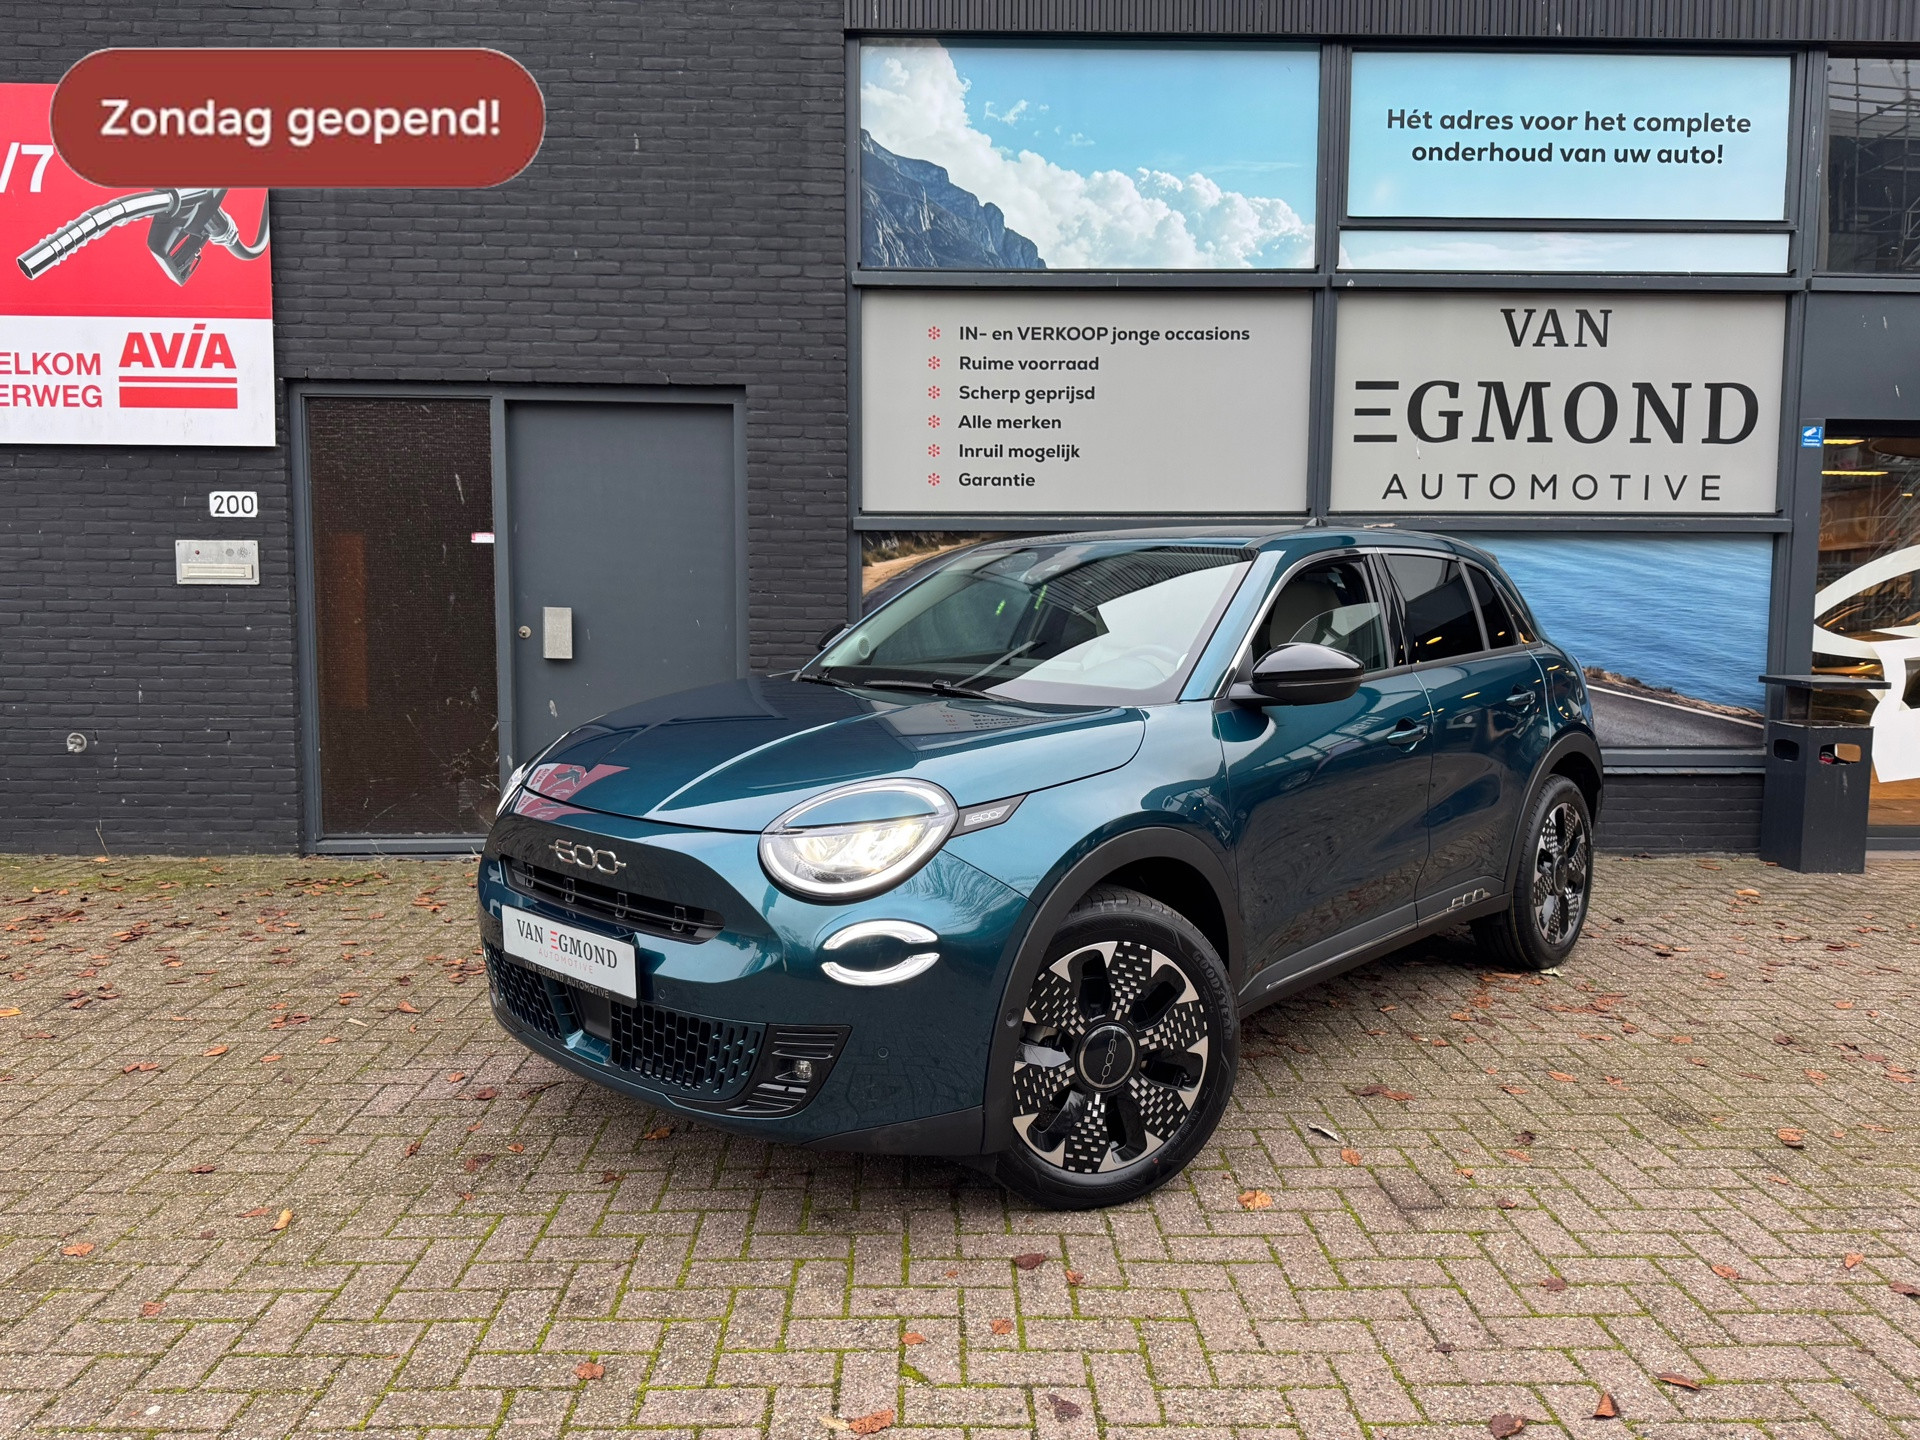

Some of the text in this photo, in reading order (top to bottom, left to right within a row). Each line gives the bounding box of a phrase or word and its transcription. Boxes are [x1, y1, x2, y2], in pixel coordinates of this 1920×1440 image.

[1387, 108, 1752, 135] Hét adres voor het complete
[1411, 141, 1724, 165] onderhoud van uw auto!
[959, 326, 1250, 346] IN- en VERKOOP jonge occasions
[1500, 308, 1613, 348] VAN
[119, 323, 237, 369] AVIA
[959, 355, 1099, 371] Ruime voorraad
[959, 385, 1095, 404] Scherp geprijsd
[957, 414, 1062, 429] Alle merken
[1353, 380, 1759, 445] EGMOND
[959, 443, 1081, 463] Inruil mogelijk
[958, 472, 1036, 487] Garantie
[1381, 473, 1721, 501] AUTOMOTIVE
[213, 494, 254, 515] 200
[549, 839, 627, 875] 600
[516, 918, 618, 970] VAN EGMOND
[538, 947, 594, 975] AUTOMOTIVE
[524, 960, 610, 999] VAN EGMOND AUTOMOTIVE
